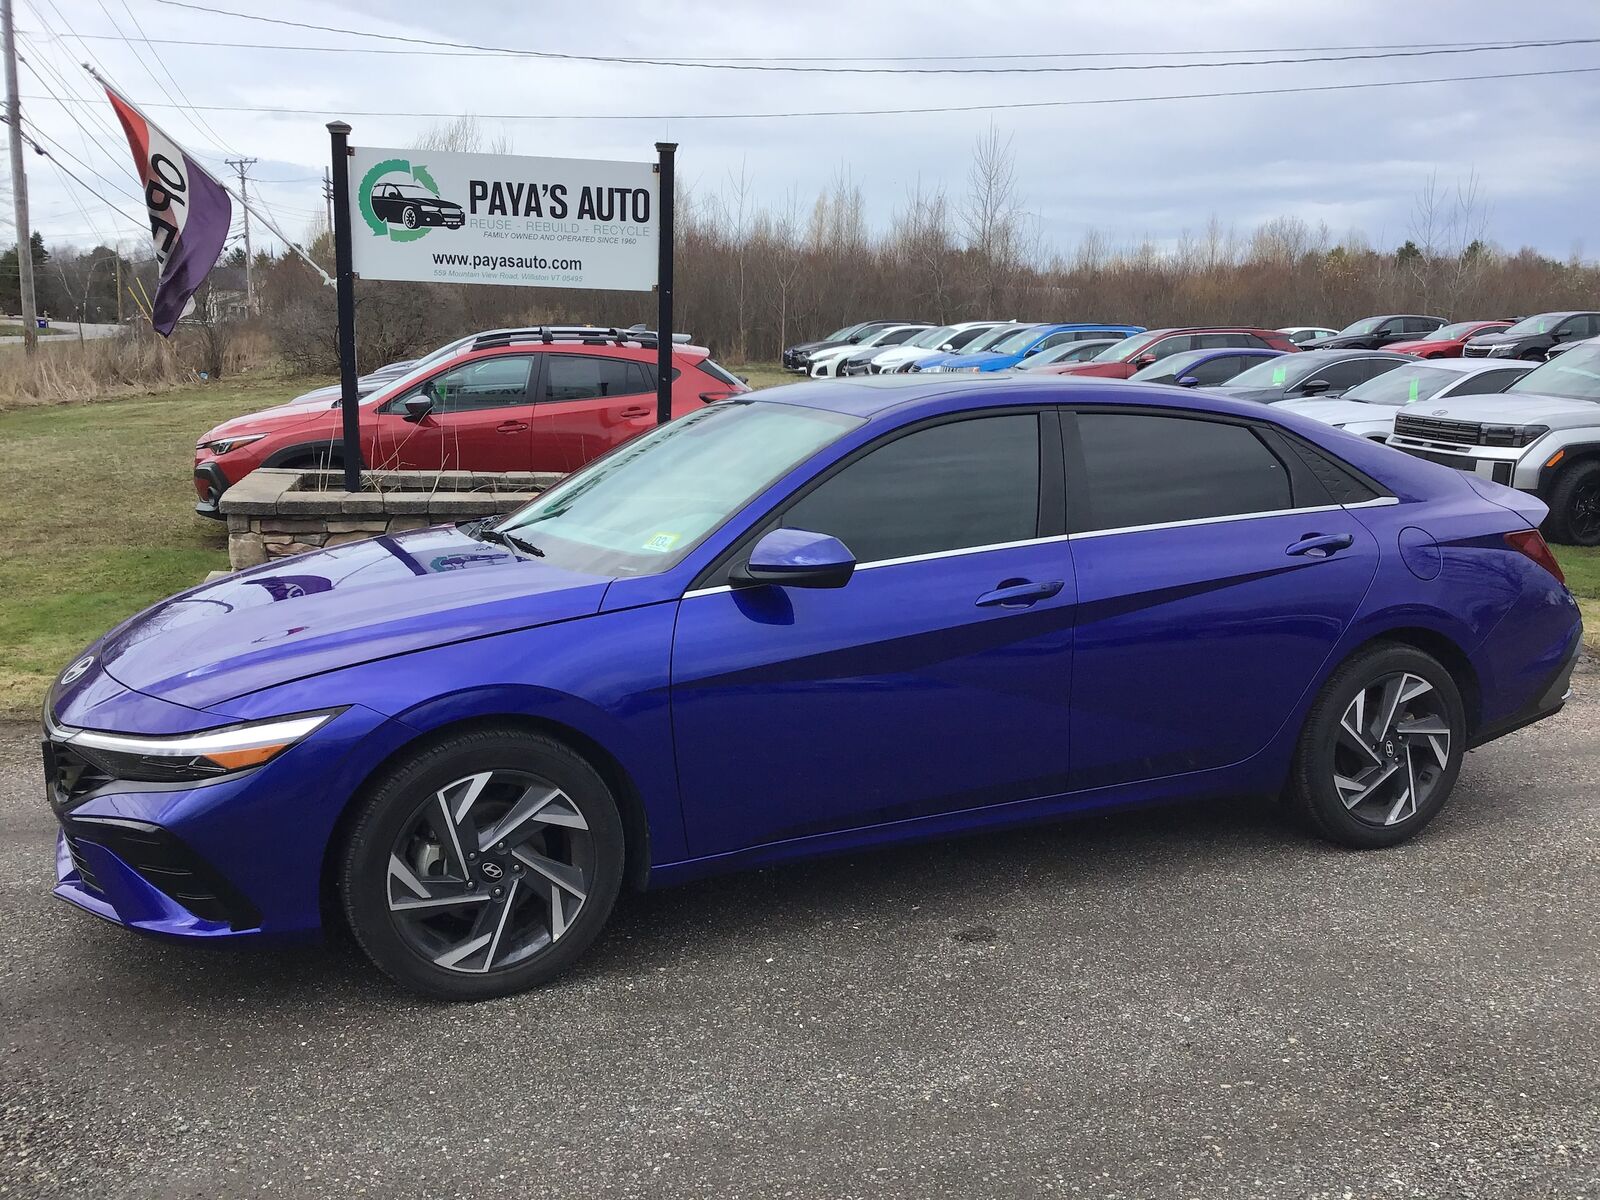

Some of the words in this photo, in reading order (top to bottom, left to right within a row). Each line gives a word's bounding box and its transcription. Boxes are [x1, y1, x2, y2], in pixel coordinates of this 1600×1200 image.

[145, 153, 187, 264] OPE
[469, 180, 568, 219] PAYA'S
[577, 186, 651, 223] AUTO
[469, 218, 512, 230] REUSE
[526, 221, 580, 233] REBUILD
[594, 225, 650, 237] RECYCLE
[483, 231, 510, 239] FAMILY
[510, 232, 539, 241] OWNED
[540, 233, 555, 241] AND
[557, 234, 596, 243] OPERATED
[597, 236, 619, 244] SINCE
[432, 253, 582, 271] www.payasauto.com
[449, 270, 480, 278] Mountain
[481, 271, 497, 279] View
[521, 273, 549, 281] Williston
